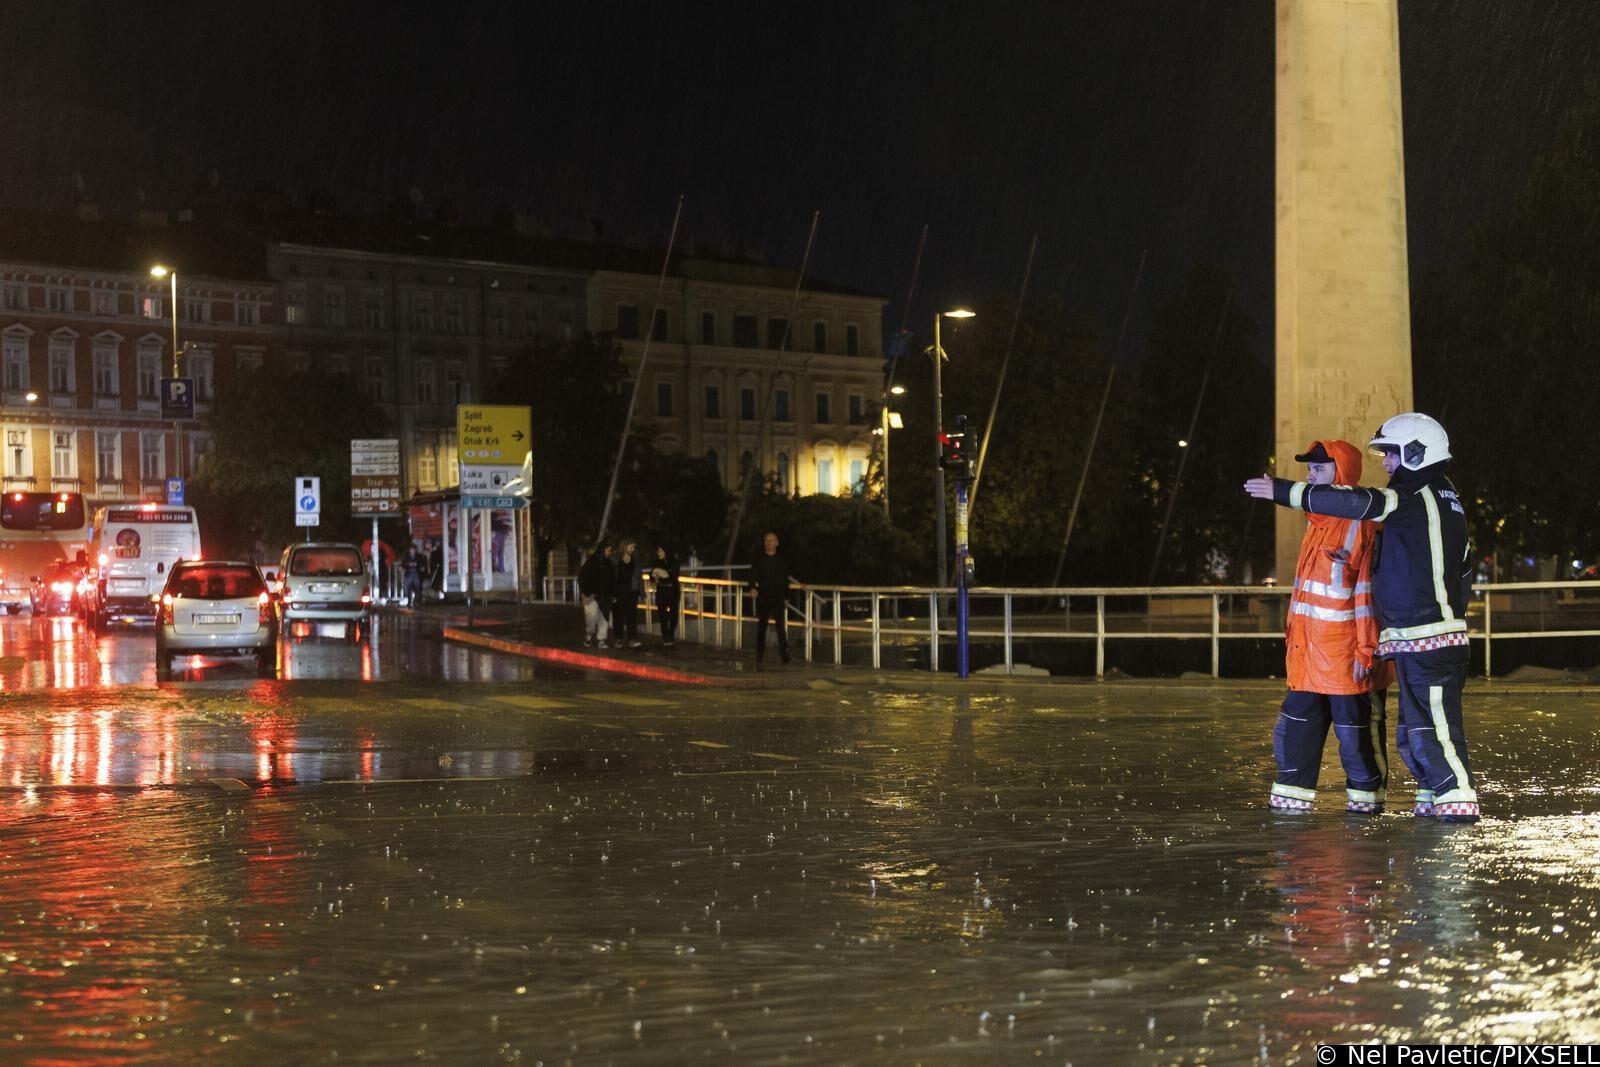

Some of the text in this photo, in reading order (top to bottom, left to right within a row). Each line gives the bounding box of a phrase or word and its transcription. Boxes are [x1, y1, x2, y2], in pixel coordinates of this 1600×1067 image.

[464, 411, 482, 421] Split
[464, 424, 493, 434] Zagreb
[464, 436, 500, 445] Otok Krk
[464, 469, 482, 478] Luka
